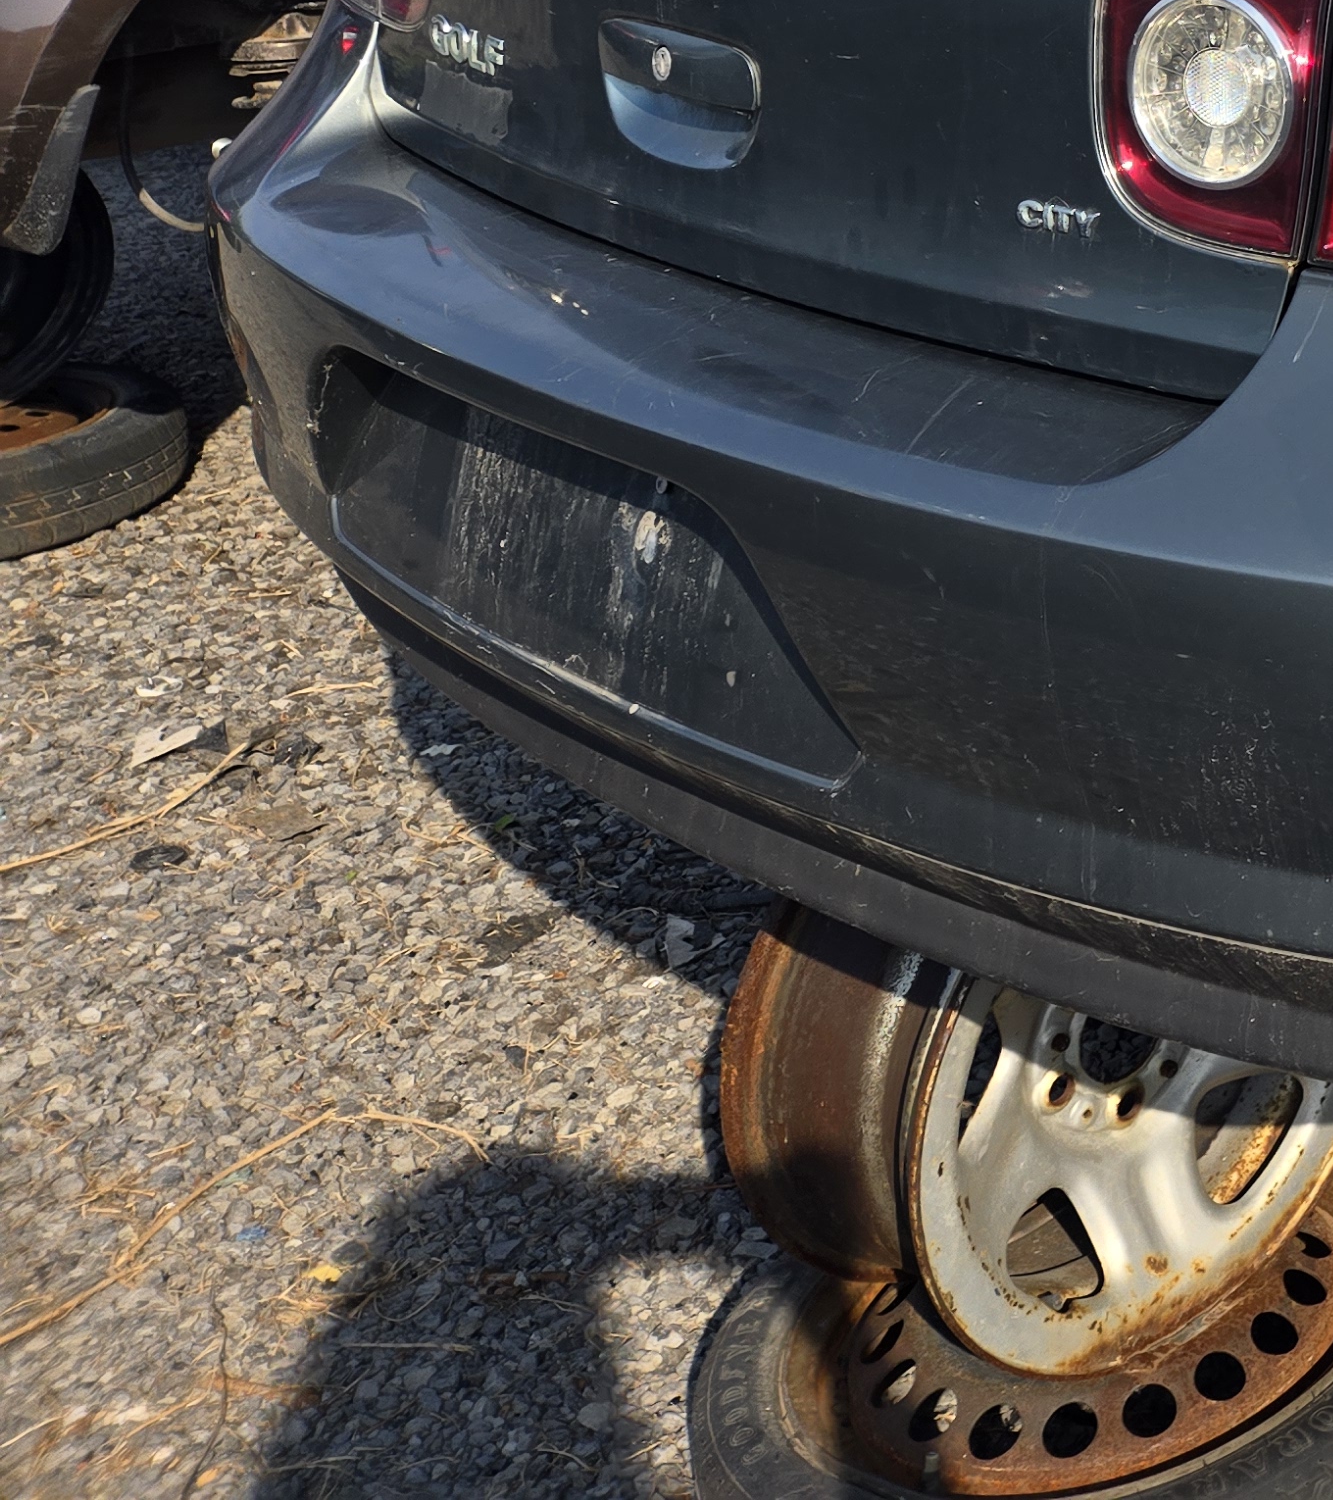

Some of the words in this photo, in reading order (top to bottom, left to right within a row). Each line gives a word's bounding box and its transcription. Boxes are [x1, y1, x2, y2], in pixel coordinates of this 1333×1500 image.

[430, 13, 505, 76] GOLF
[1017, 199, 1101, 238] CITY
[718, 1294, 773, 1467] GOODYE
